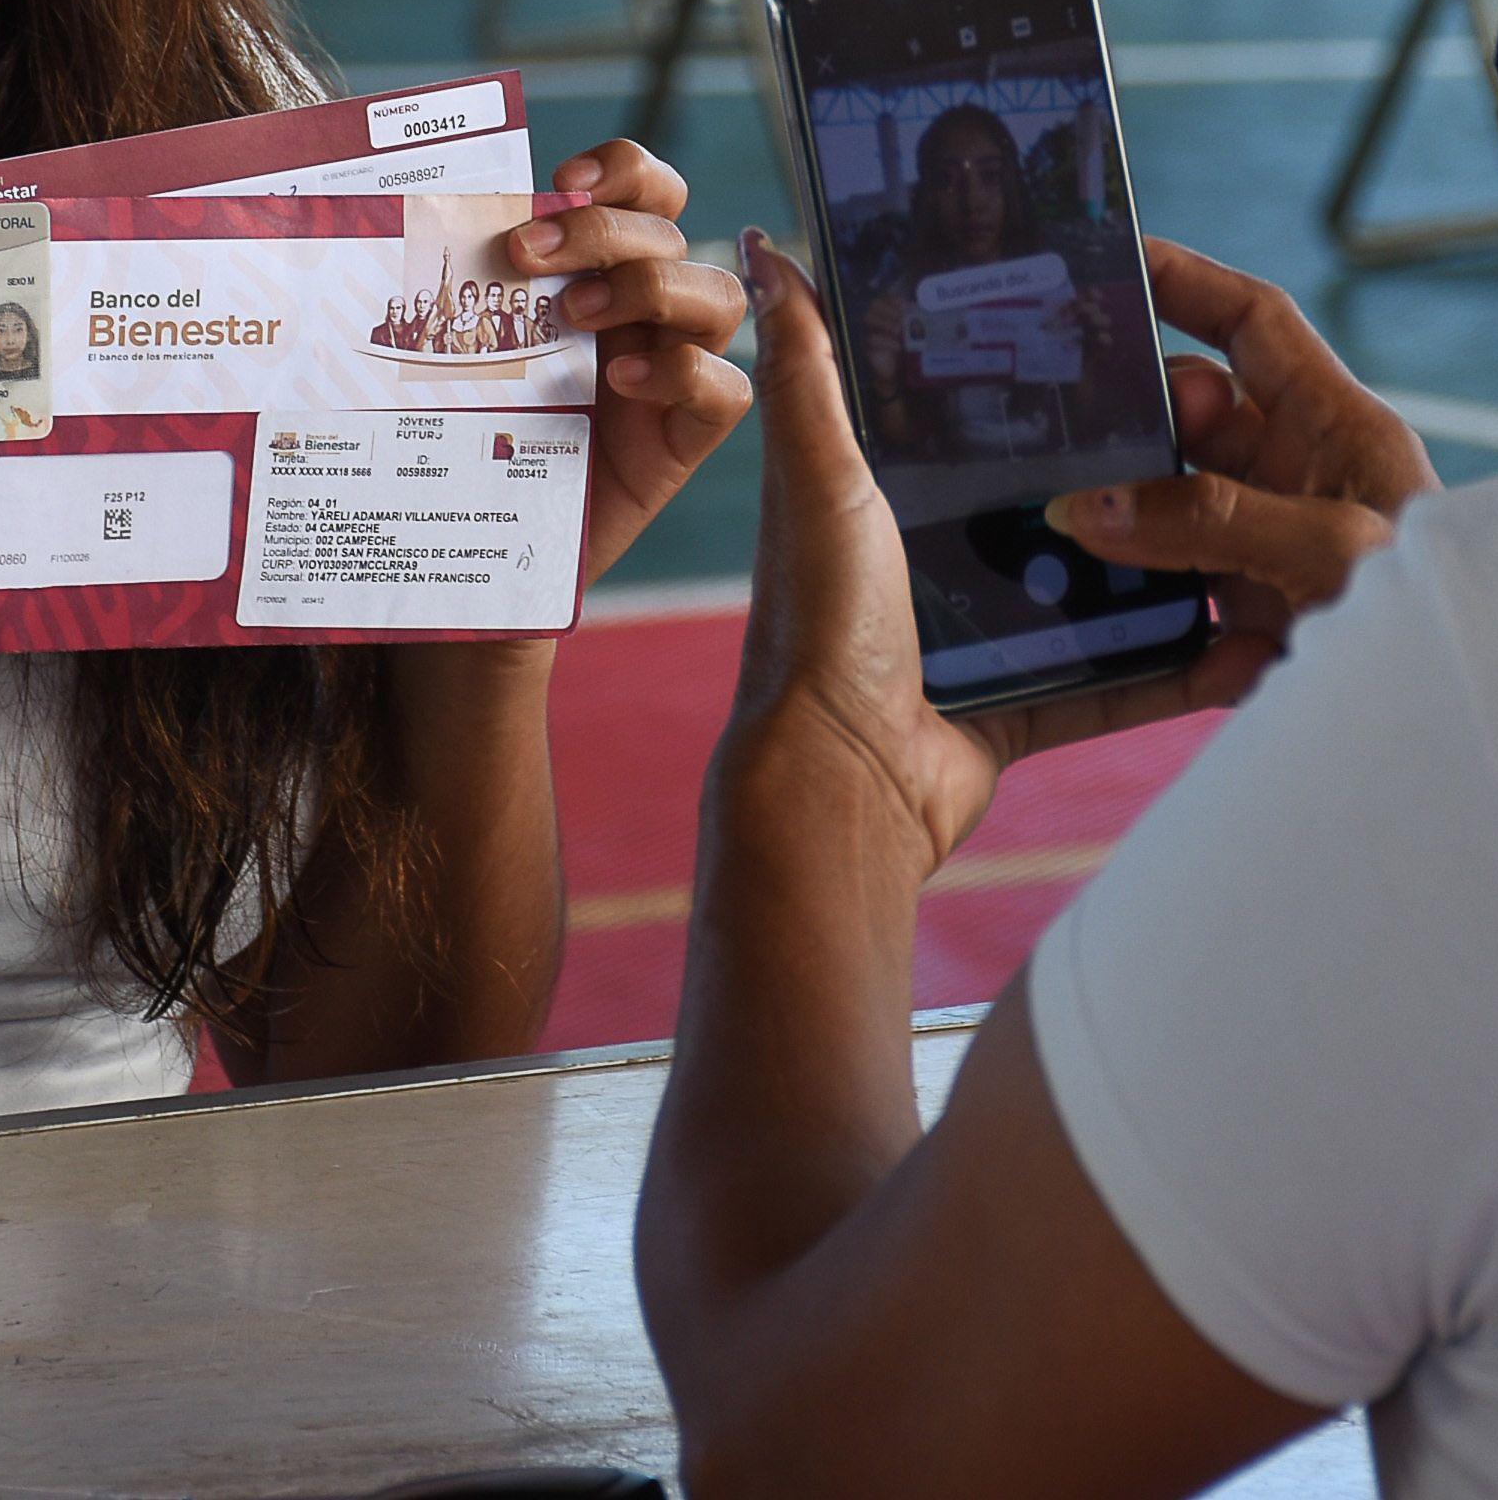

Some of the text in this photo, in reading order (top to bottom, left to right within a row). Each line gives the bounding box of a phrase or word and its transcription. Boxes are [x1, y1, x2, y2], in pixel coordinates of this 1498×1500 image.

[374, 103, 420, 119] NÚMERO
[404, 114, 467, 138] 0003412
[379, 165, 446, 189] 005988927
[7, 277, 35, 286] SEXO M
[90, 289, 200, 308] Banco del
[89, 314, 281, 347] Bienestar
[88, 352, 214, 362] El banco de los mexicanos
[398, 417, 444, 427] JÓVENES
[305, 440, 361, 451] Bienestar
[519, 445, 580, 456] BIENESTAR
[273, 452, 309, 465] Tarjeta:
[417, 455, 430, 465] ID:
[508, 457, 548, 467] Número:
[271, 466, 372, 477] XXXX XXXX XX18 5666
[396, 467, 449, 478] 005988927
[507, 468, 548, 479] 0003412
[104, 492, 146, 503] F25 P12
[268, 497, 337, 511] Región: 04_01
[266, 510, 519, 523] Nombre: YARELI ADAMARI VILLANUEVA ORTEGA
[265, 522, 380, 533] Estado: 04 CAMPECHE
[264, 535, 396, 546] Municipio: 002 CAMPECHE
[263, 548, 509, 559] Localidad: 0001 SAN FRANCISCO DE CAMPECHE
[262, 560, 418, 571] CURP: VIOY030907MCCLRRA9
[260, 571, 491, 584] Sucursal: 01477 CAMPECHE SAN FRANCISCO
